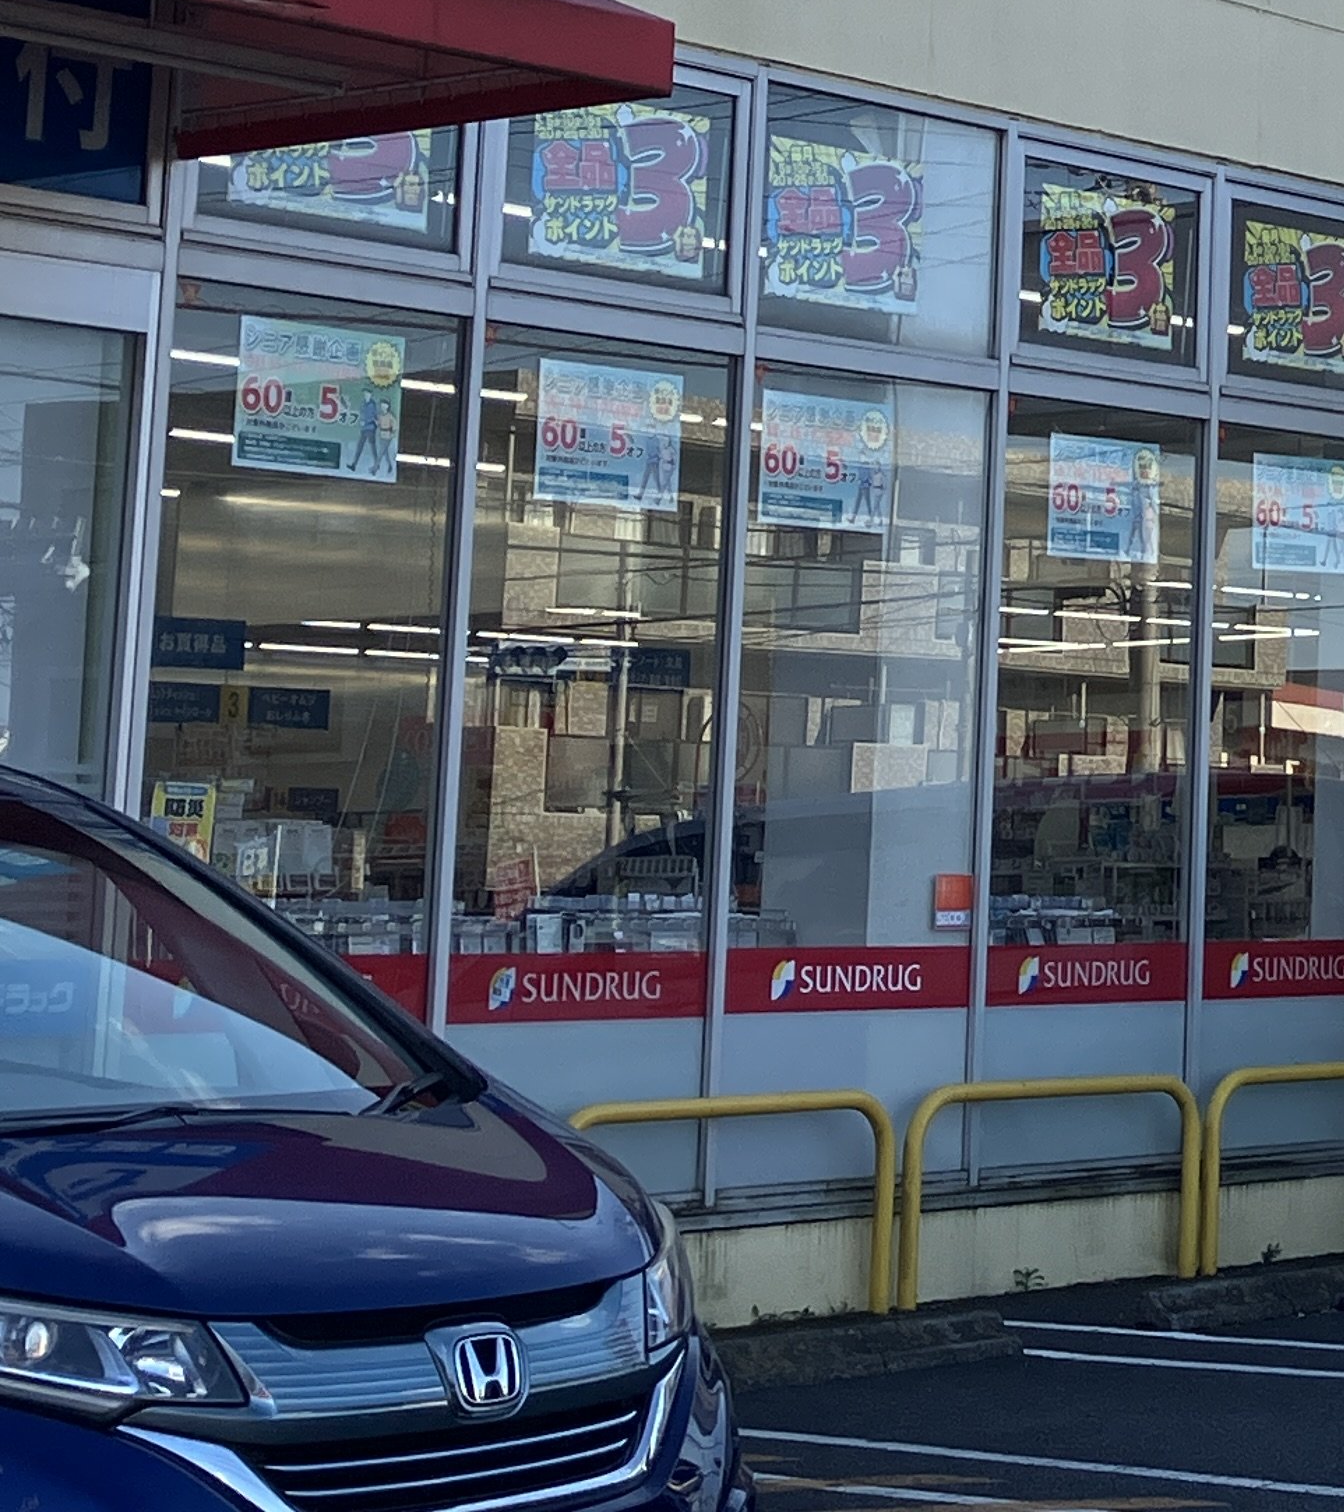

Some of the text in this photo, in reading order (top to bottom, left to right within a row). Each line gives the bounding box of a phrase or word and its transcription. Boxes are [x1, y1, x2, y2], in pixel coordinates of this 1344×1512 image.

[247, 162, 330, 188] ポイント
[615, 118, 700, 251] 3
[546, 217, 619, 241] ポイント
[840, 161, 915, 290] 3
[779, 259, 843, 282] ポイント
[1103, 209, 1168, 327] 3
[1051, 297, 1107, 320] ポイント
[241, 376, 284, 414] 60
[319, 385, 340, 422] 5
[541, 416, 578, 452] 60
[609, 423, 627, 457] 5
[764, 443, 798, 478] 60
[824, 447, 841, 483] 5
[1052, 482, 1080, 514] 60
[227, 691, 239, 719] 3
[521, 970, 662, 1003] SUNDRUG
[799, 964, 922, 994] SUNDRUG
[1043, 959, 1150, 987] SUNDRUG
